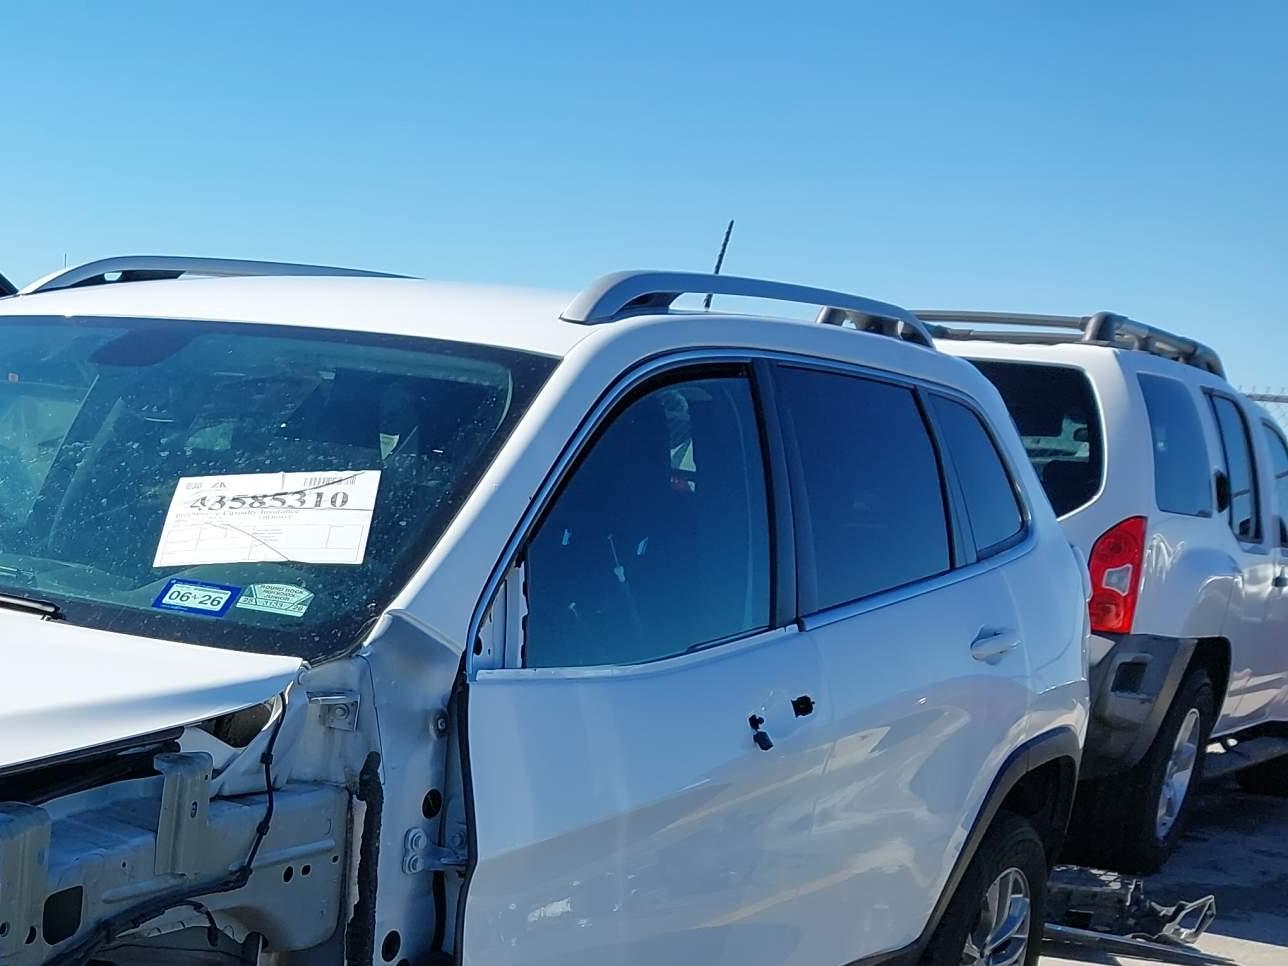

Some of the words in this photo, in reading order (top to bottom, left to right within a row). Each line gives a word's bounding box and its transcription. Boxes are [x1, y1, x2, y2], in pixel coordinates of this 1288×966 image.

[190, 491, 349, 511] 43585310
[168, 590, 192, 602] 06
[198, 594, 223, 606] 26
